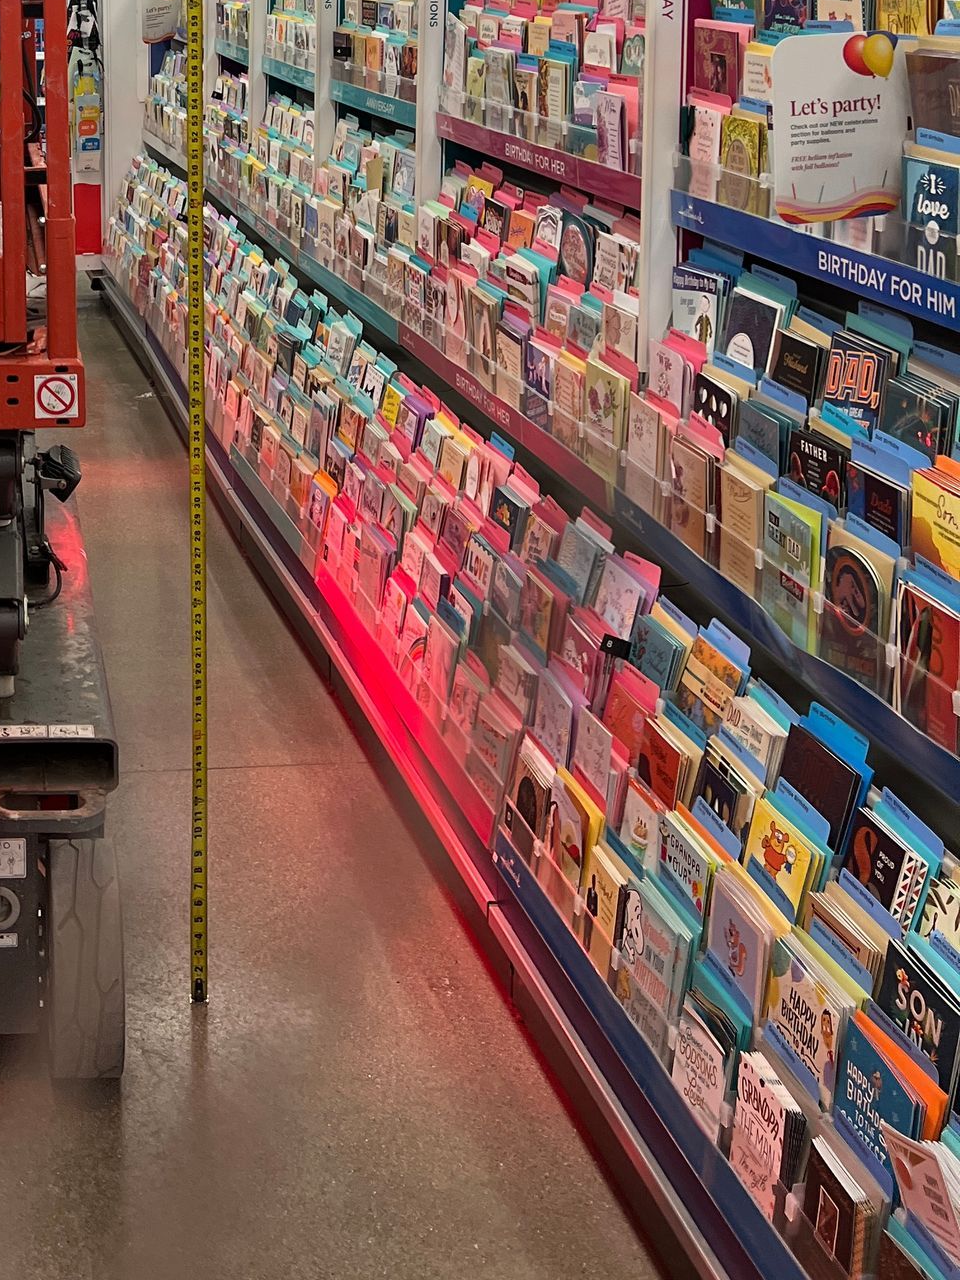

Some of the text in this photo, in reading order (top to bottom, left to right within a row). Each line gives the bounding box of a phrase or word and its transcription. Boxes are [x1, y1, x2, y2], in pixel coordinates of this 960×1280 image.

[192, 49, 197, 61] 57
[366, 96, 396, 115] ANNIVERSARY
[790, 94, 882, 118] Let’s party!
[192, 115, 198, 127] 53
[844, 118, 878, 126] celebrations
[821, 128, 845, 136] balloons
[791, 139, 806, 147] party
[504, 142, 566, 177] BIRTHDAY FOR HER
[192, 182, 198, 193] 49
[917, 193, 950, 220] love
[193, 265, 198, 276] 44
[917, 244, 946, 280] DAD
[818, 250, 956, 318] BIRTHDAY FOR HIM
[193, 331, 199, 342] 40
[825, 349, 880, 410] DAD,
[455, 373, 511, 427] BIRTHDAY FOR HER
[194, 414, 199, 426] 35
[800, 439, 828, 463] FATHER
[194, 514, 200, 526] 29
[195, 564, 200, 576] 26
[195, 648, 201, 658] 21
[196, 713, 201, 723] 17
[878, 850, 896, 870] PROUD
[790, 986, 817, 1029] HAPPY
[895, 981, 944, 1049] SON
[781, 998, 819, 1059] BIRTHDAY
[846, 1060, 875, 1103] HAPPY
[741, 1077, 780, 1142] GRANDPA
[753, 1130, 776, 1178] MAN
